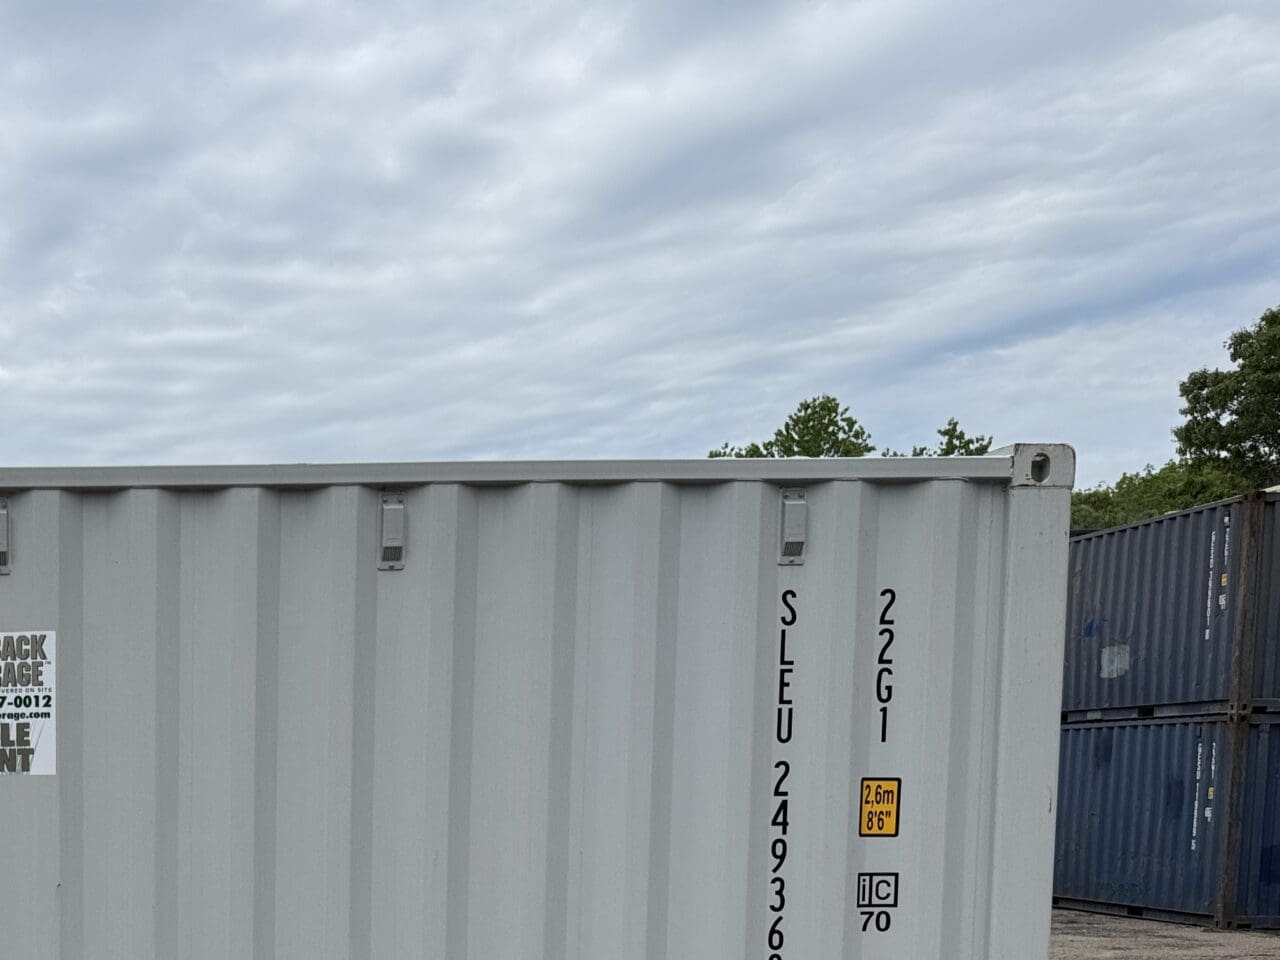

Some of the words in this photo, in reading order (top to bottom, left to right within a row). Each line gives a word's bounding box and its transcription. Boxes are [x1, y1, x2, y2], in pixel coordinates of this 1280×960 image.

[776, 589, 797, 744] SLEU
[876, 588, 896, 743] 22G1
[864, 784, 895, 808] 2,6m
[866, 810, 891, 831] 8'6"
[860, 911, 891, 932] 70
